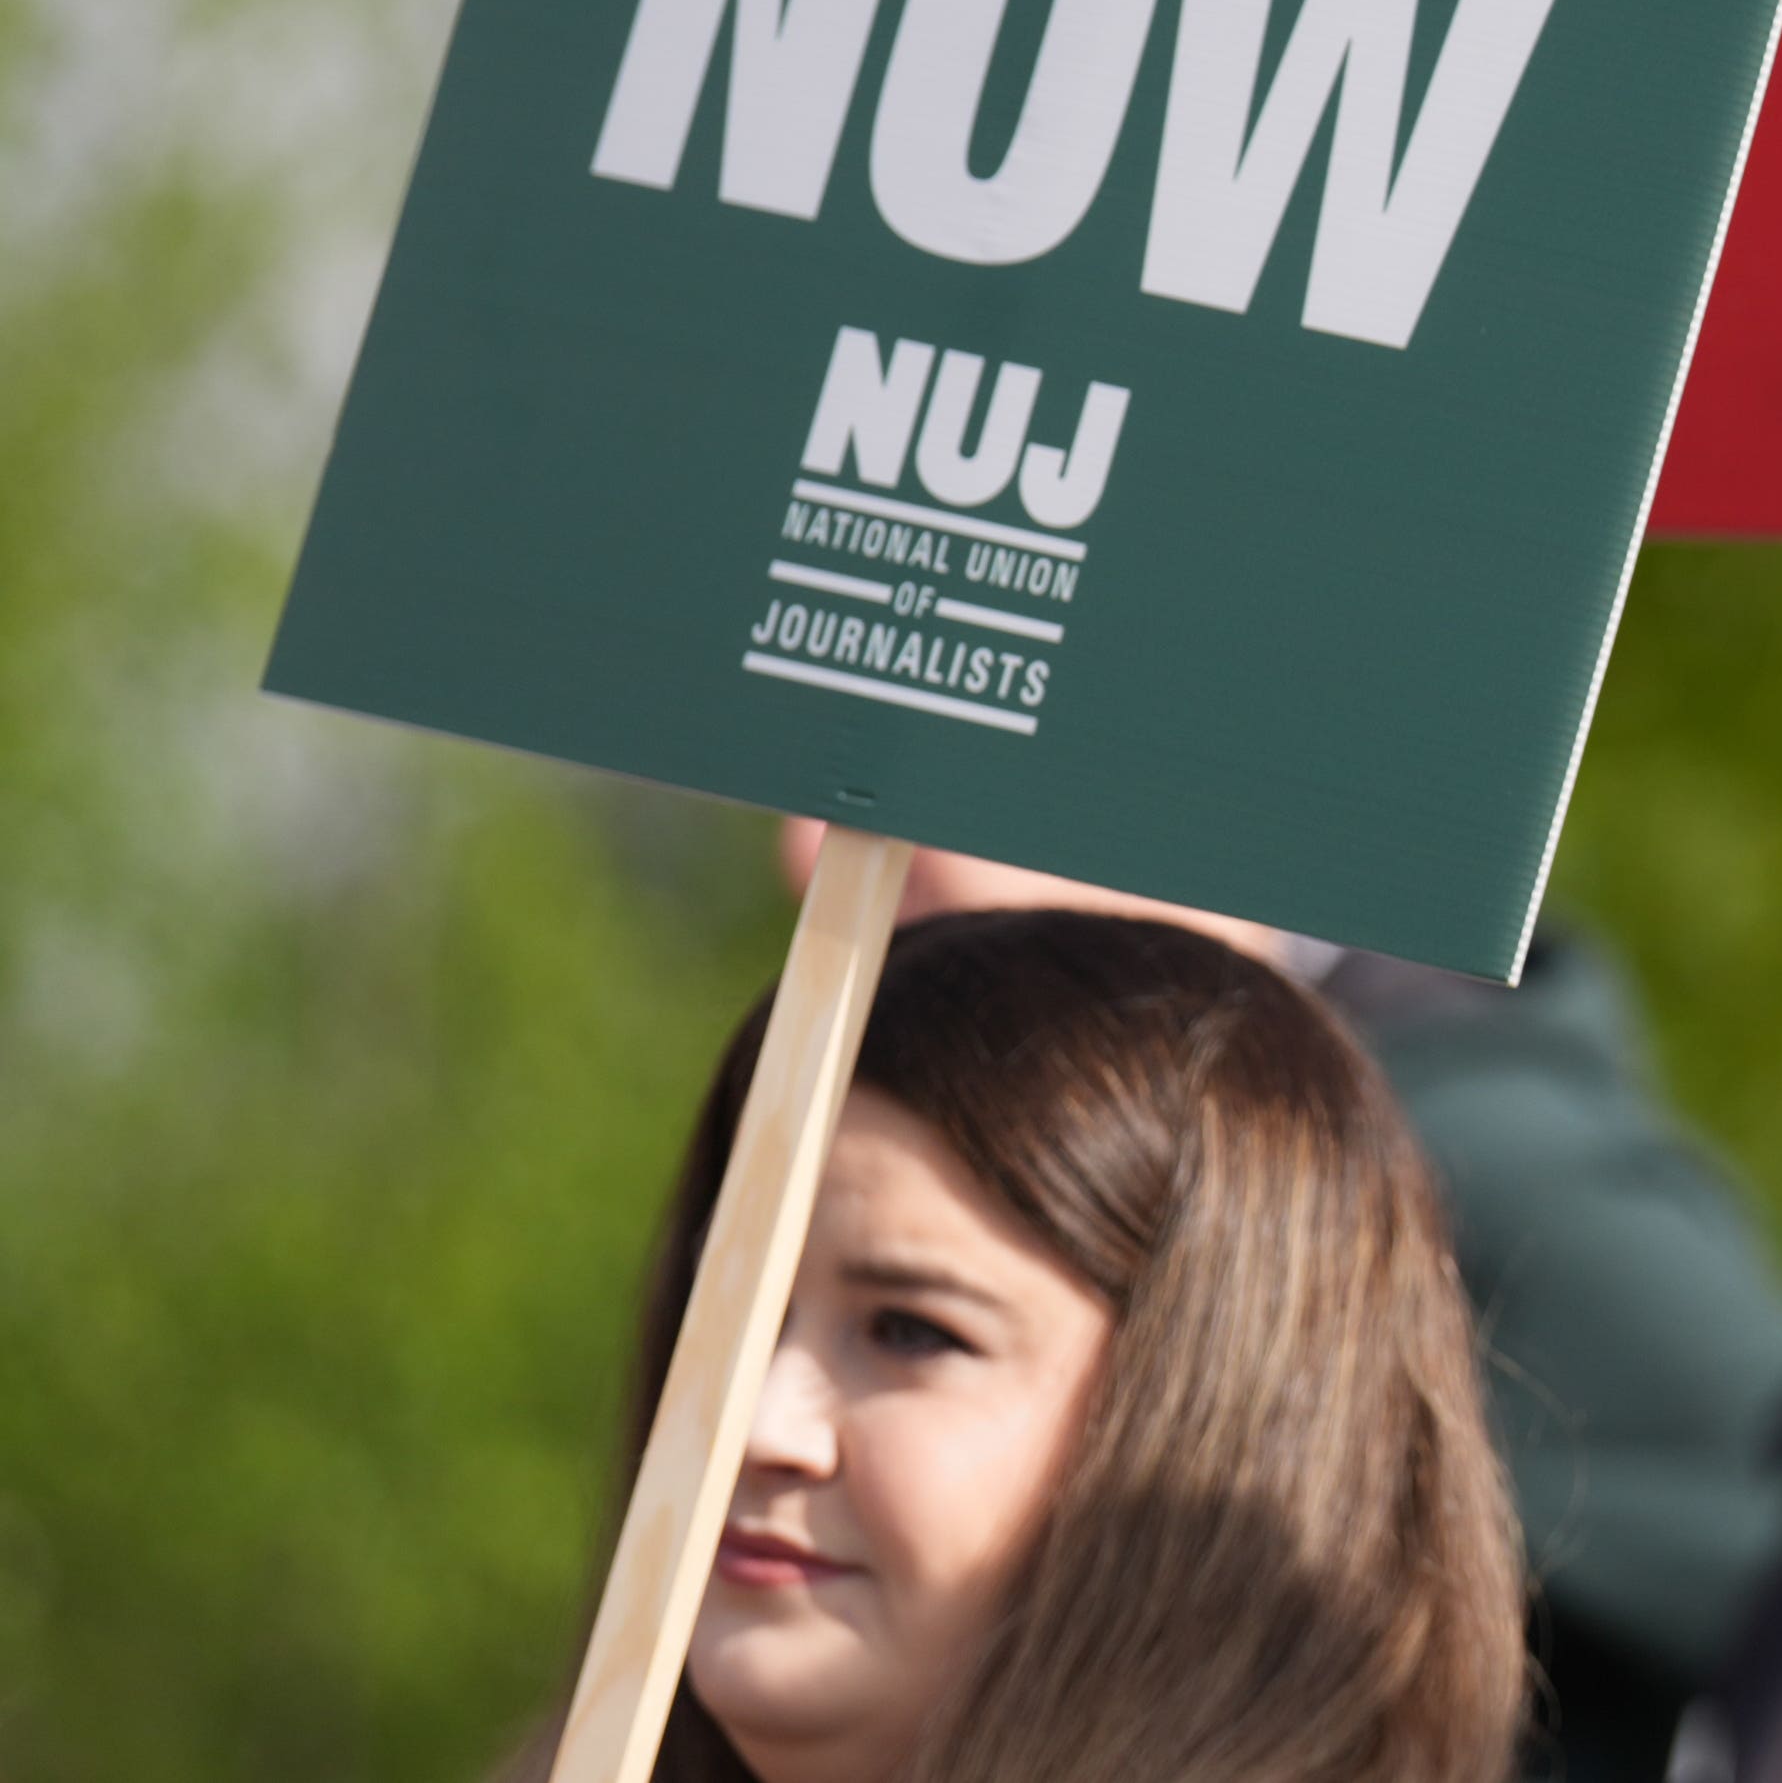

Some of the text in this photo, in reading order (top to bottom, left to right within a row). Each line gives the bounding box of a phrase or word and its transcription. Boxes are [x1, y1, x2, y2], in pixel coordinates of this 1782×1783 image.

[801, 325, 1131, 529] NUJ
[781, 501, 1080, 602] NATIONAL UNION
[894, 581, 936, 618] OF
[751, 599, 1051, 707] JOURNALISTS
